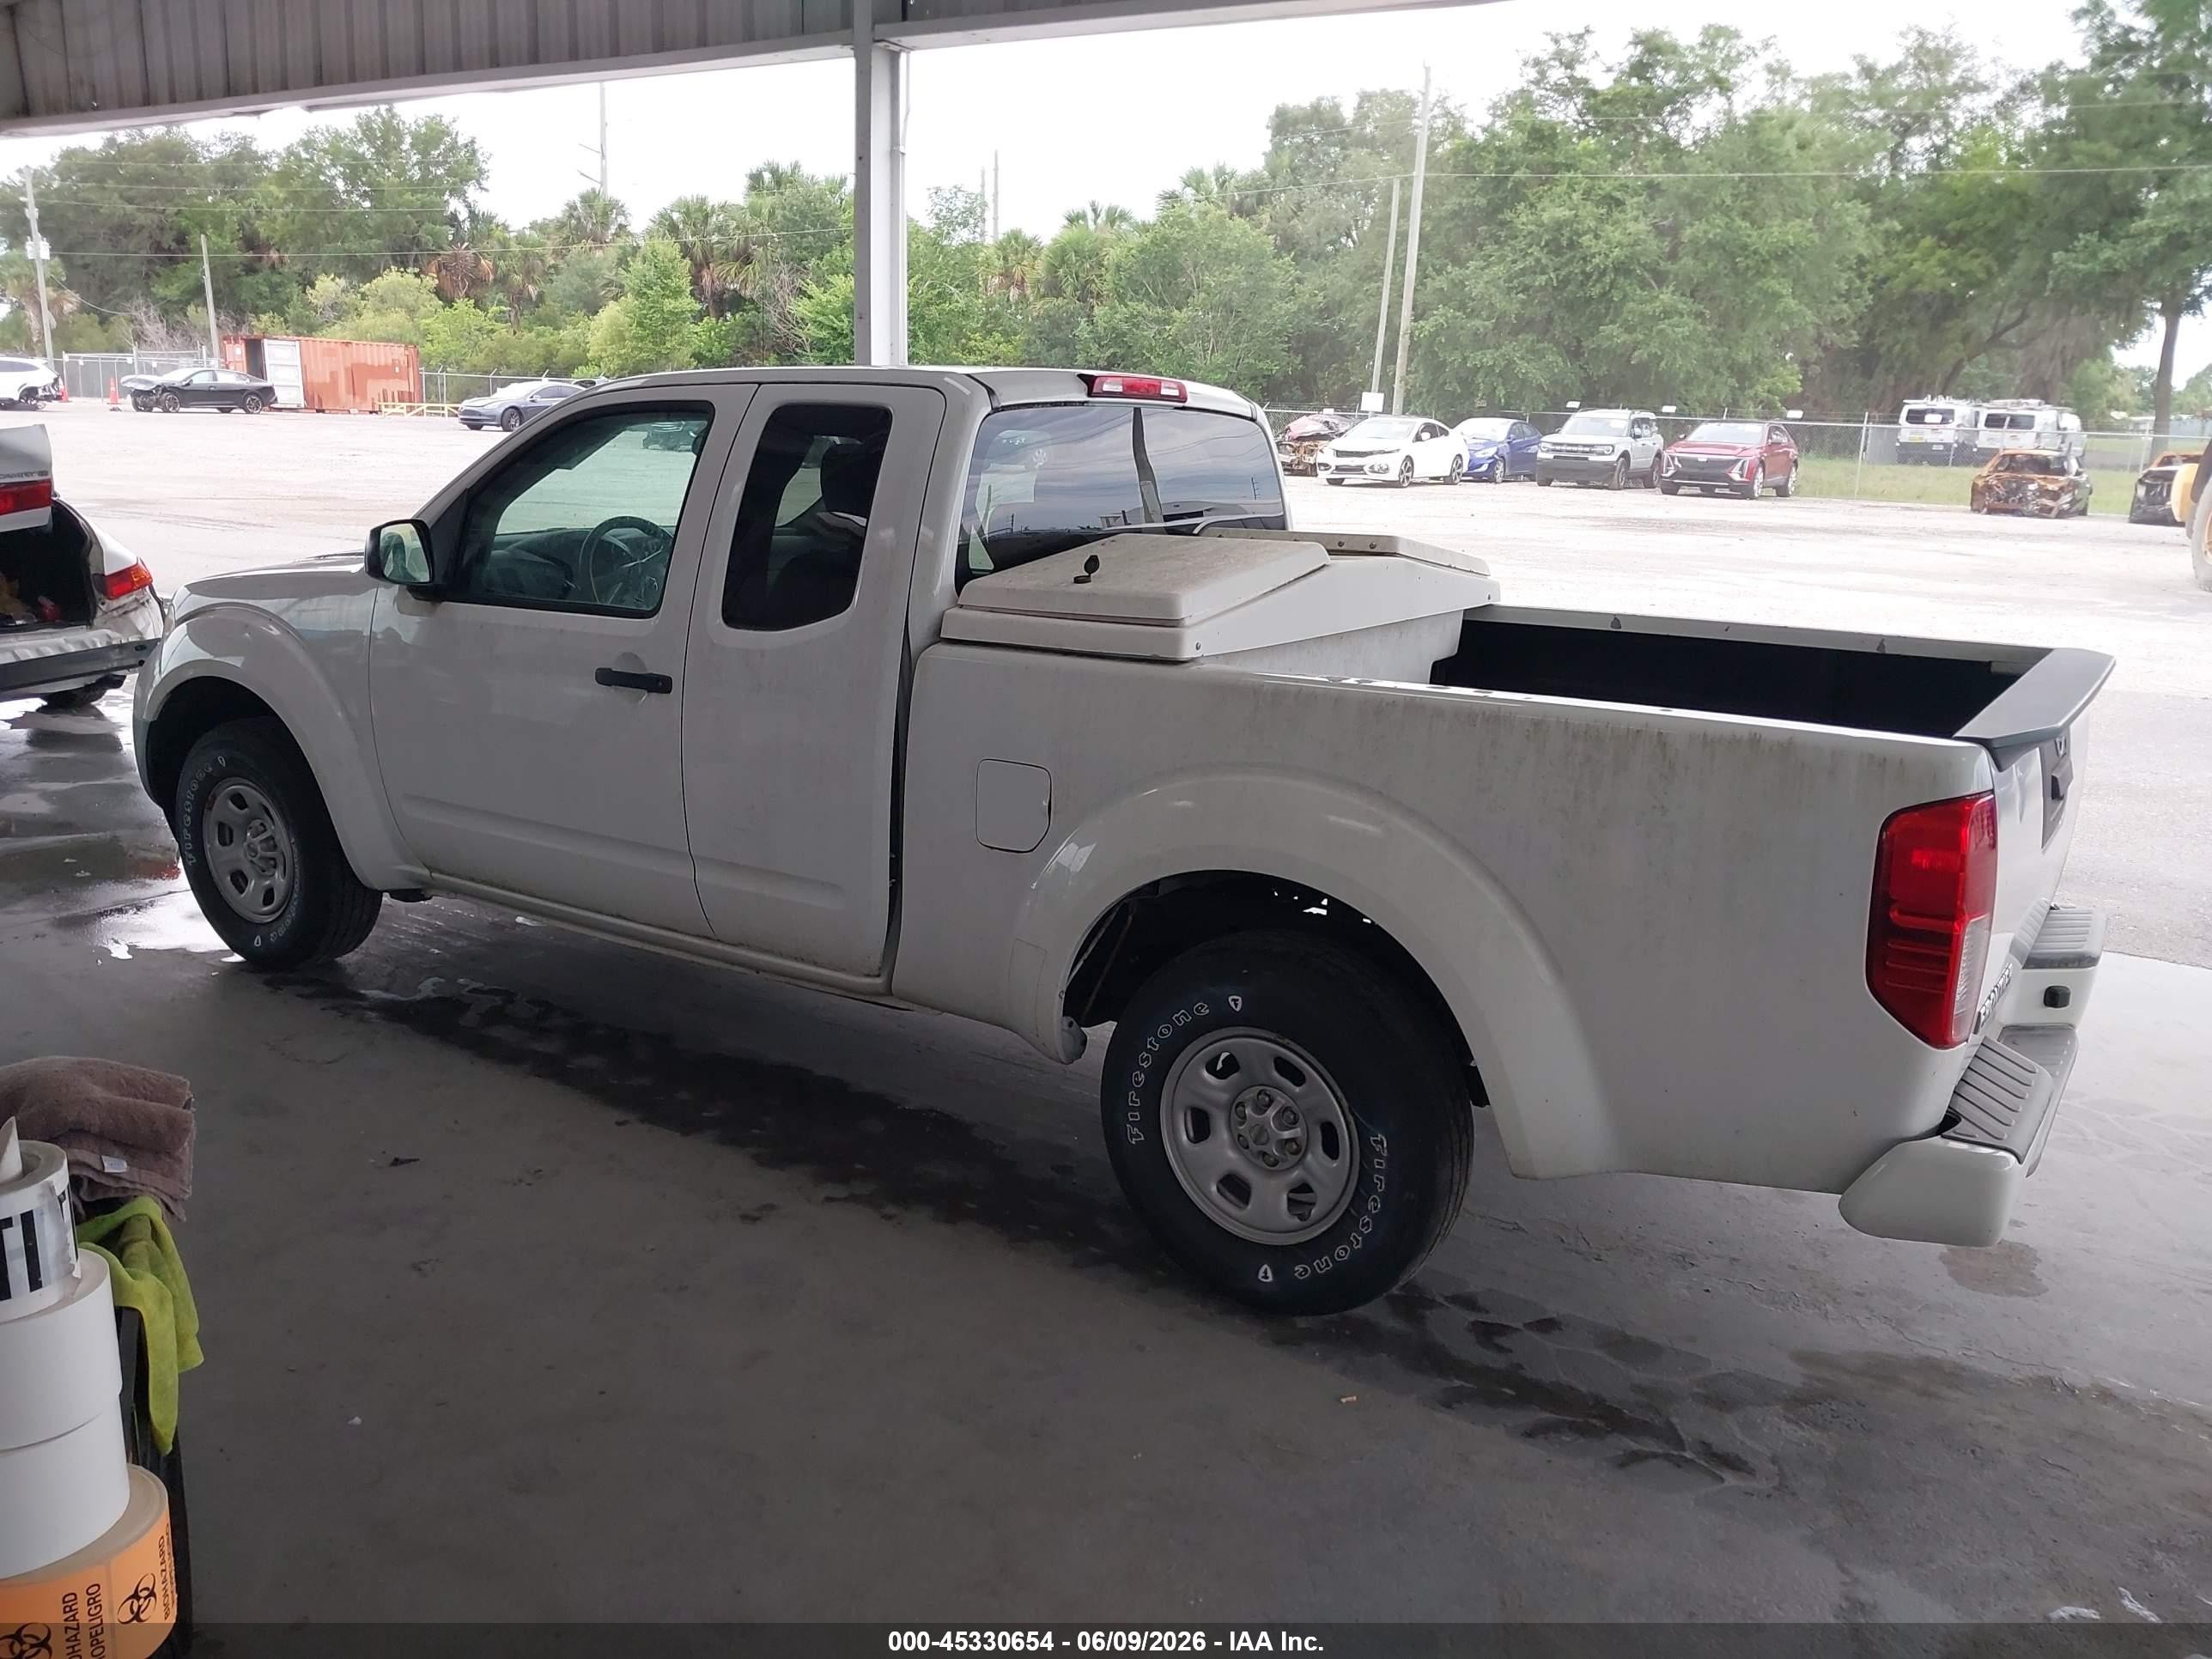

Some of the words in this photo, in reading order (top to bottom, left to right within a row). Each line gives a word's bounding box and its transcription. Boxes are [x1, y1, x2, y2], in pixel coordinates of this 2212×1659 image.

[1127, 1002, 1210, 1145] Firestone
[1294, 1133, 1388, 1279] Firestone
[85, 1583, 106, 1659] OPELIGRO
[158, 1535, 171, 1621] BIOHAZARD
